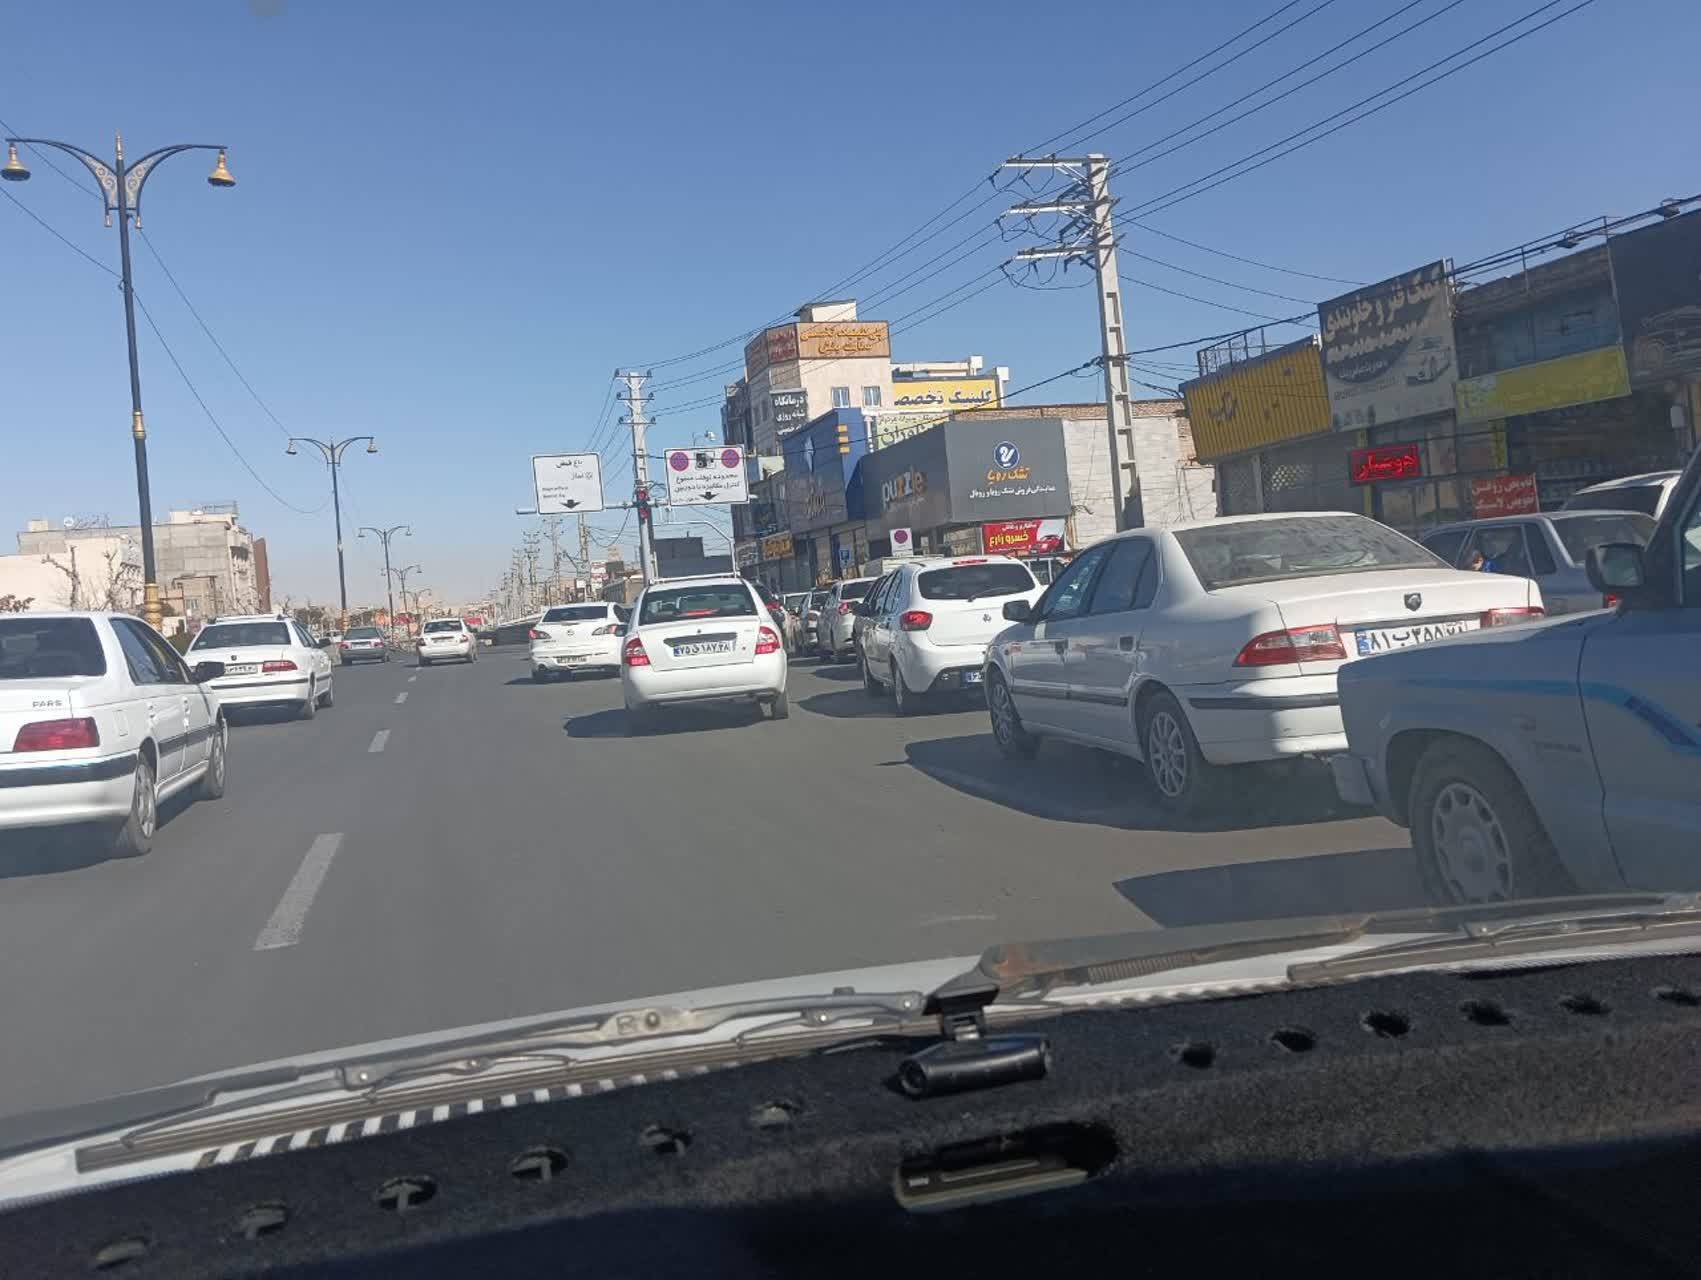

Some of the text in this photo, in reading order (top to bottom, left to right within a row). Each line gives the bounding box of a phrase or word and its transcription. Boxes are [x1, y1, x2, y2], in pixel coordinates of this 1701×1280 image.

[774, 395, 804, 407] درمانگاه
[949, 390, 991, 403] کلینیک
[1005, 531, 1029, 544] خسرو
[32, 699, 63, 707] PARS
